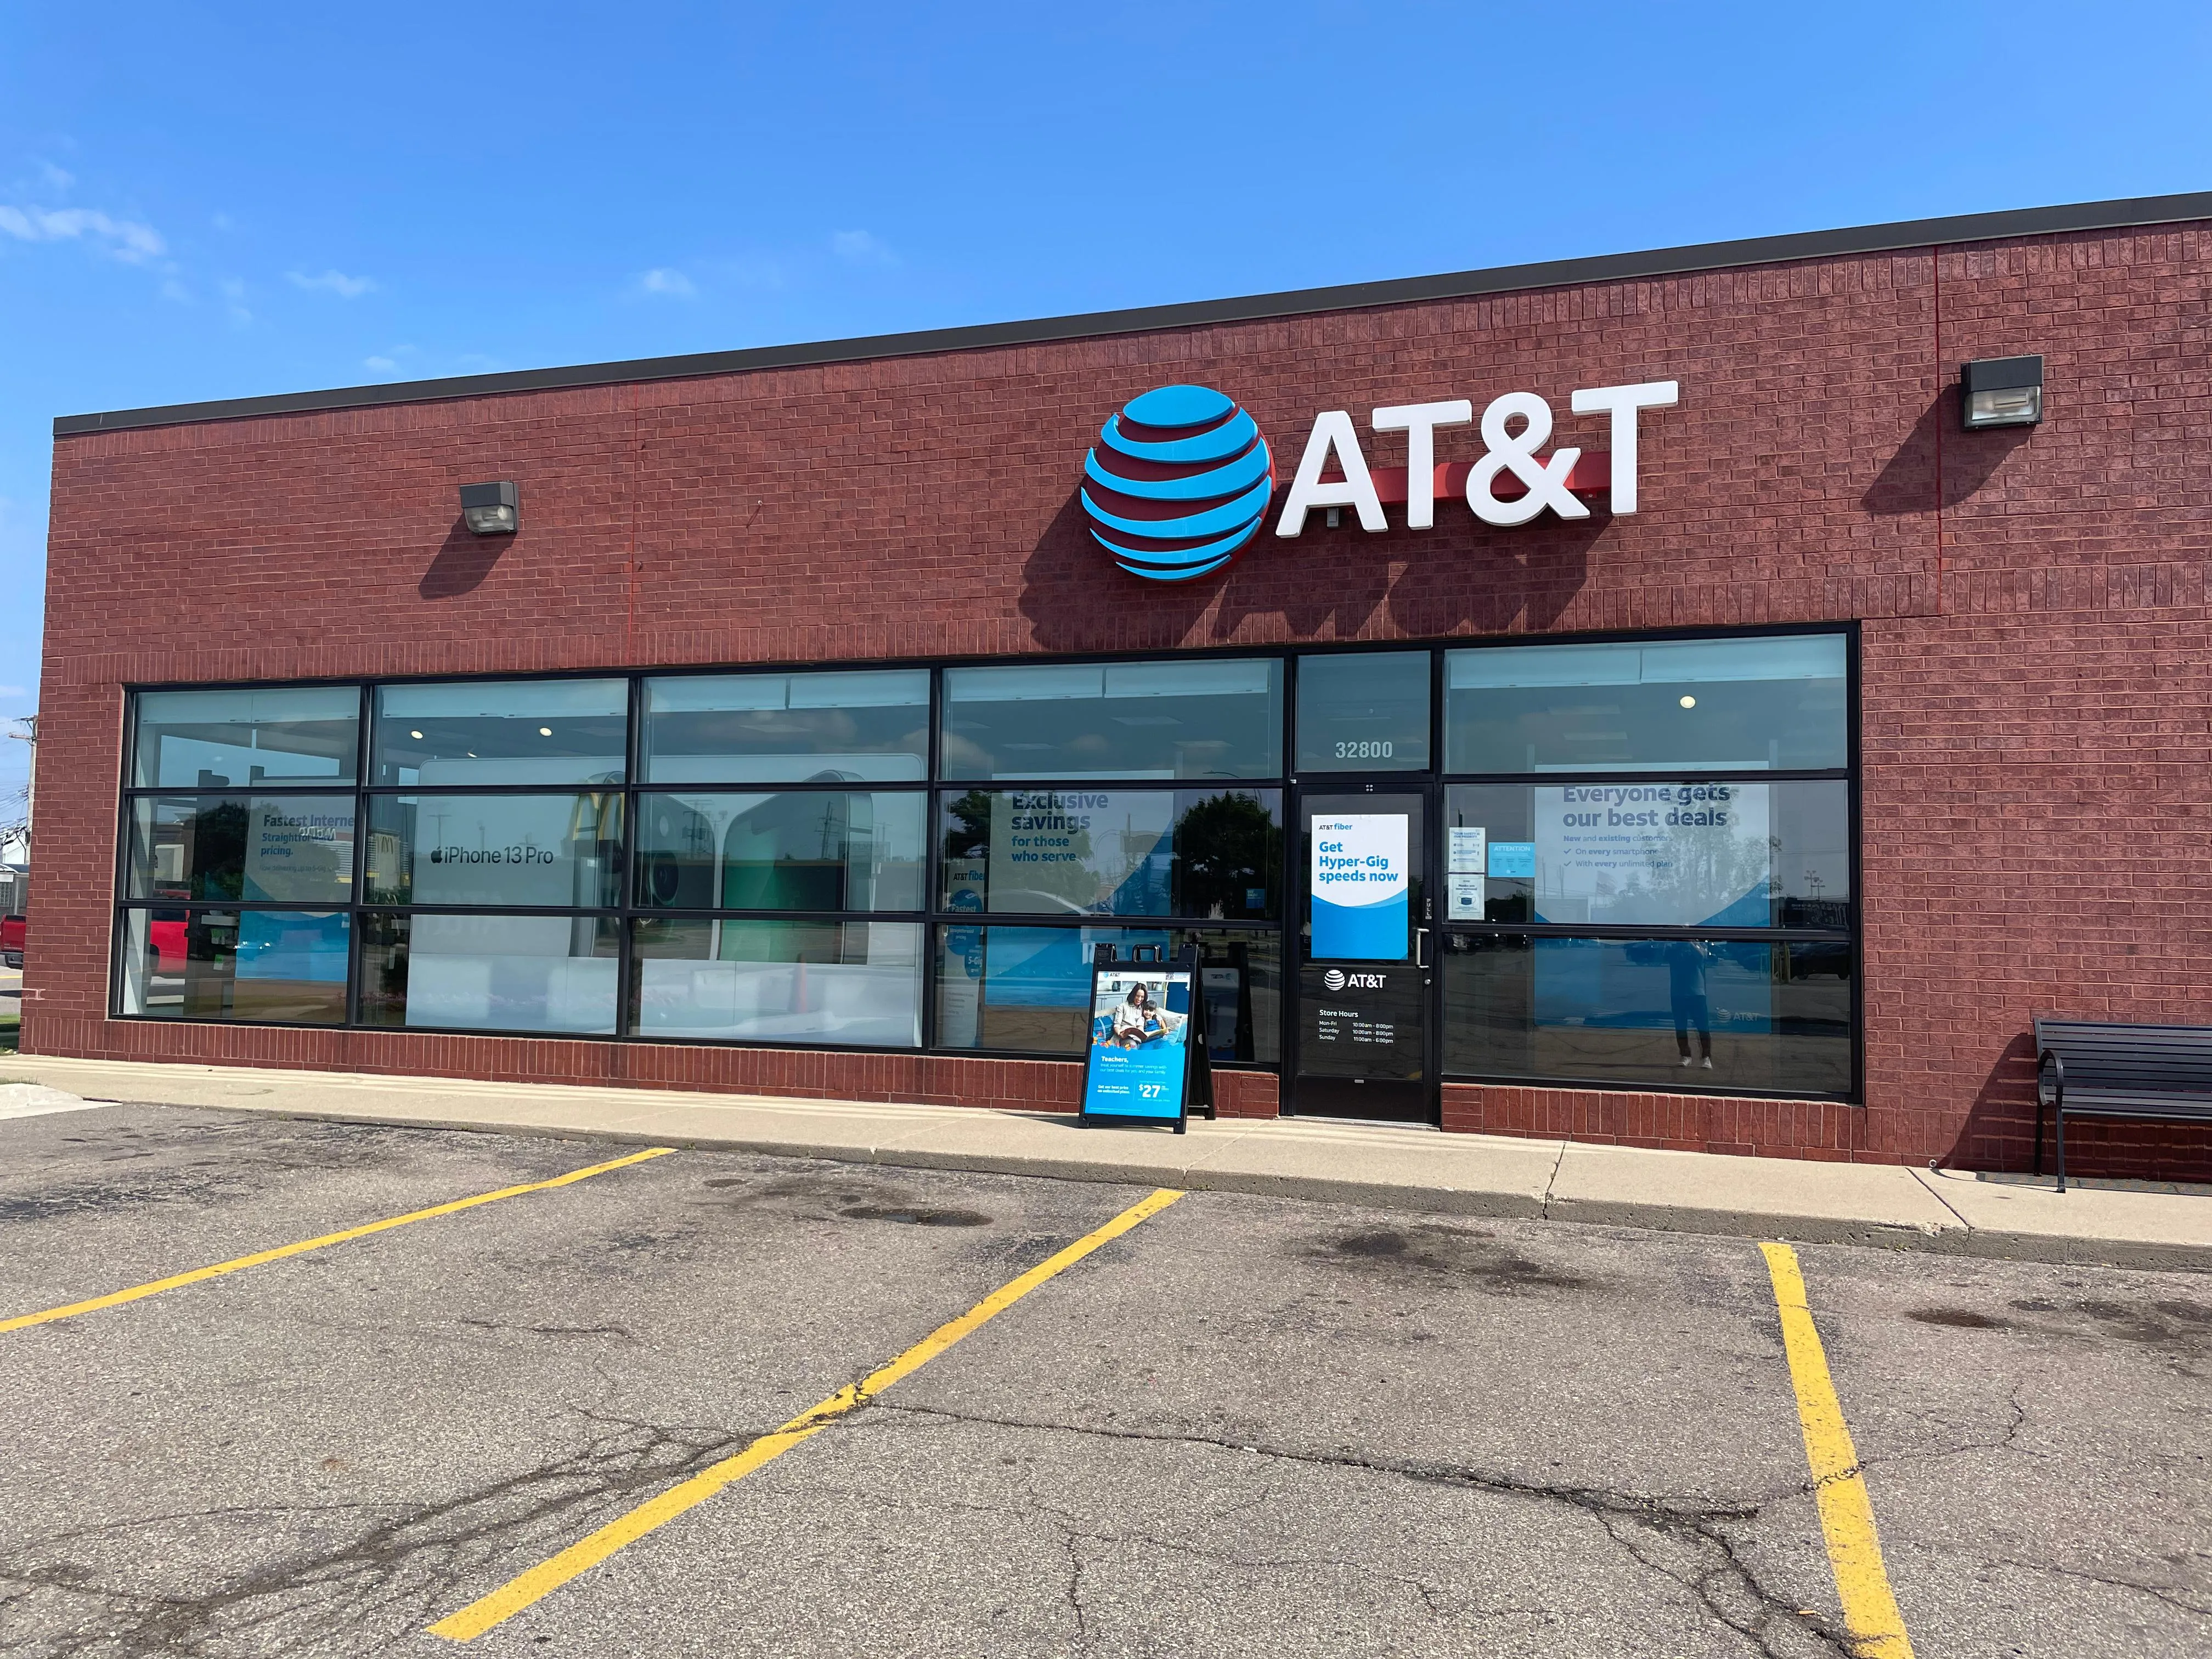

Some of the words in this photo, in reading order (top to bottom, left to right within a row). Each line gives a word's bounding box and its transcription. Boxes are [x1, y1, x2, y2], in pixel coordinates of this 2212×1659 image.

[1276, 380, 1679, 538] AT&T
[1335, 741, 1393, 758] 32800
[1013, 792, 1108, 809] Exclusive
[1564, 786, 1672, 806] Everyone
[1677, 784, 1730, 806] gets
[264, 814, 307, 827] Fastest
[311, 814, 354, 827] Interne
[1011, 811, 1091, 834] savings
[1563, 812, 1601, 827] our
[1607, 808, 1658, 827] best
[1664, 807, 1728, 826] deals
[1012, 836, 1031, 847] for
[1034, 836, 1069, 847] those
[1599, 834, 1630, 843] existing
[261, 845, 294, 857] pricing.
[1319, 842, 1343, 852] Get
[444, 847, 501, 864] iPhone
[504, 847, 522, 864] 13
[526, 847, 554, 864] Pro
[1011, 850, 1039, 861] who
[1042, 853, 1076, 861] serve
[1319, 855, 1389, 870] Hyper-Gig
[1656, 860, 1673, 868] plan
[1319, 870, 1366, 884] speeds
[1369, 873, 1398, 882] now
[952, 904, 977, 912] Fastest
[968, 956, 983, 967] 5-Gig
[1347, 974, 1387, 988] AT&T
[1733, 1012, 1759, 1022] AT&T
[1138, 1084, 1161, 1098] $27
